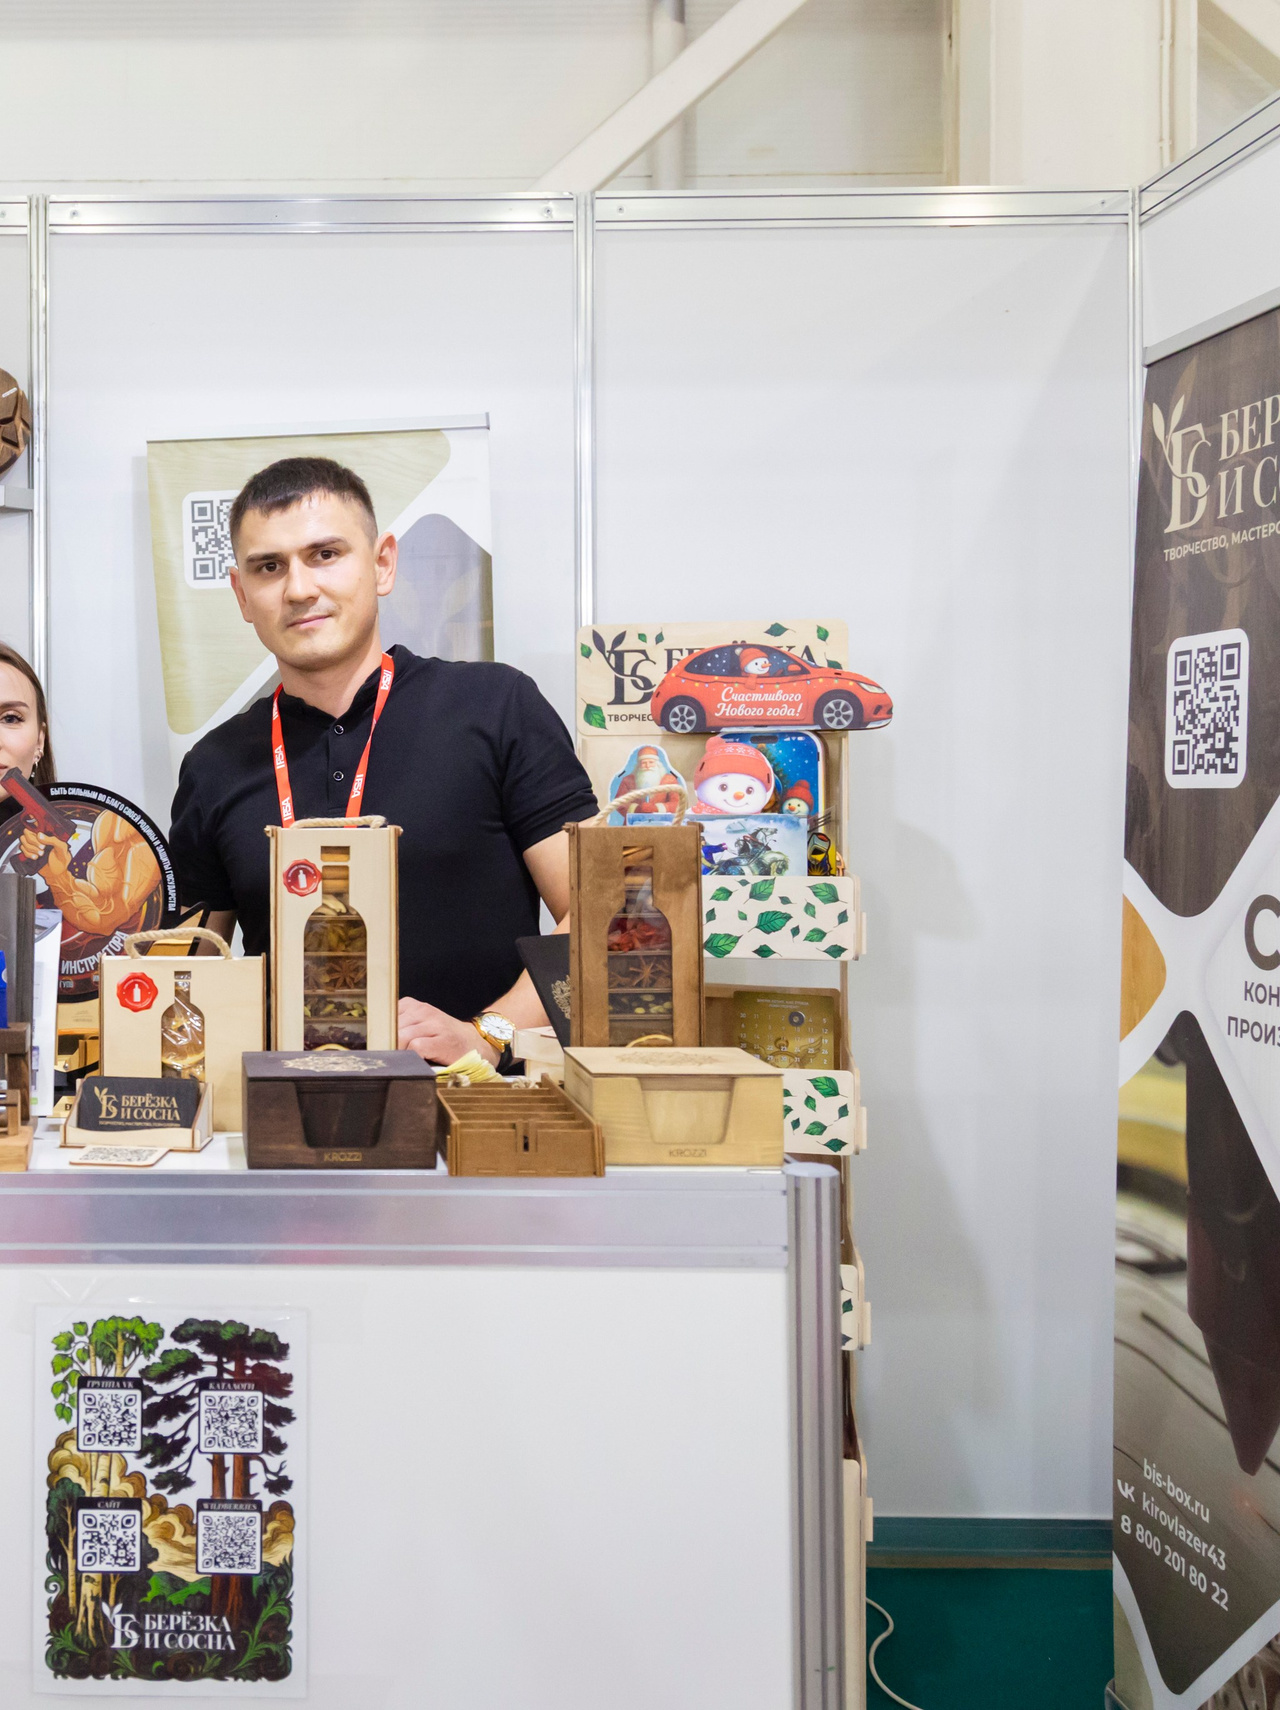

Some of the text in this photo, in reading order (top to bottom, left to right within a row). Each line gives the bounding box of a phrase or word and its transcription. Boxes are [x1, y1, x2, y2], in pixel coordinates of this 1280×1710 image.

[1217, 456, 1280, 519] И С
[1164, 534, 1228, 562] ТВОРЧЕСТВО,
[721, 687, 801, 702] Счастливого
[607, 713, 653, 722] ТВОРЧЕС
[715, 702, 802, 717] Нового года!
[50, 787, 67, 795] БЫТЬ
[68, 788, 98, 799] СИЛЬНЫМ
[98, 793, 105, 802] ВО
[106, 796, 125, 811] БЛАГО
[123, 807, 141, 823] СВОЕЙ
[138, 818, 158, 842] РОДИНЫ
[165, 871, 177, 912] ГОСУДАРСТВА
[61, 930, 130, 974] ИНСТРУТОРА
[121, 1093, 178, 1108] БЕРЁЗКА
[121, 1108, 180, 1120] И СОСНА
[1143, 1458, 1210, 1523] bis-box.ru
[97, 1500, 121, 1508] САЙТ
[1142, 1492, 1226, 1571] kirovlazer43
[1121, 1514, 1228, 1611] 8 800 201 80 22
[144, 1611, 231, 1632] БЕРЁЗКА
[144, 1632, 236, 1650] И СОСНА
